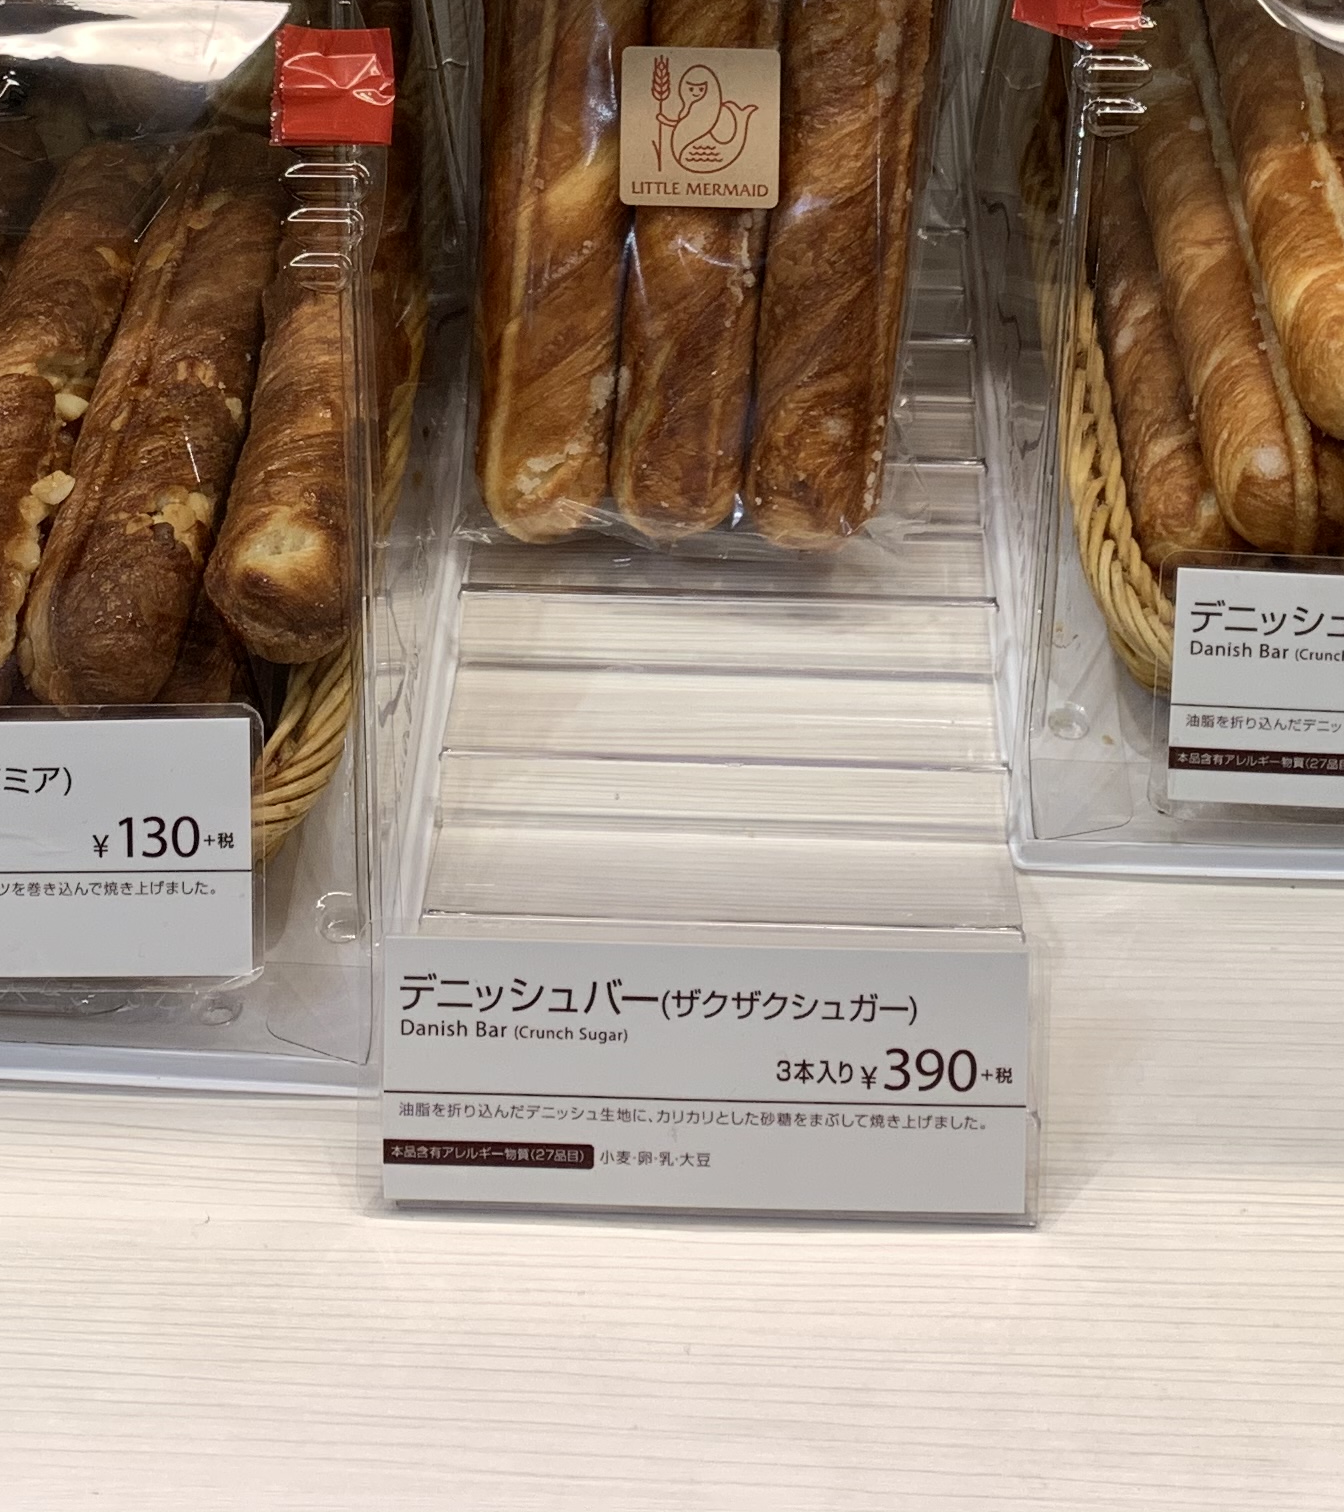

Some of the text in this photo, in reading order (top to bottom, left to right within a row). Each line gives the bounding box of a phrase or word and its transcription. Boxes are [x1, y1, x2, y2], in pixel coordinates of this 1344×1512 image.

[631, 181, 769, 198] LITTLE MERMAID
[1189, 640, 1253, 659] Danish
[1259, 643, 1291, 661] Bar
[398, 972, 919, 1026] デニッシュバー(ザクザクシュガー)
[399, 1018, 630, 1045] Danish Bar (Crunch Sugar)
